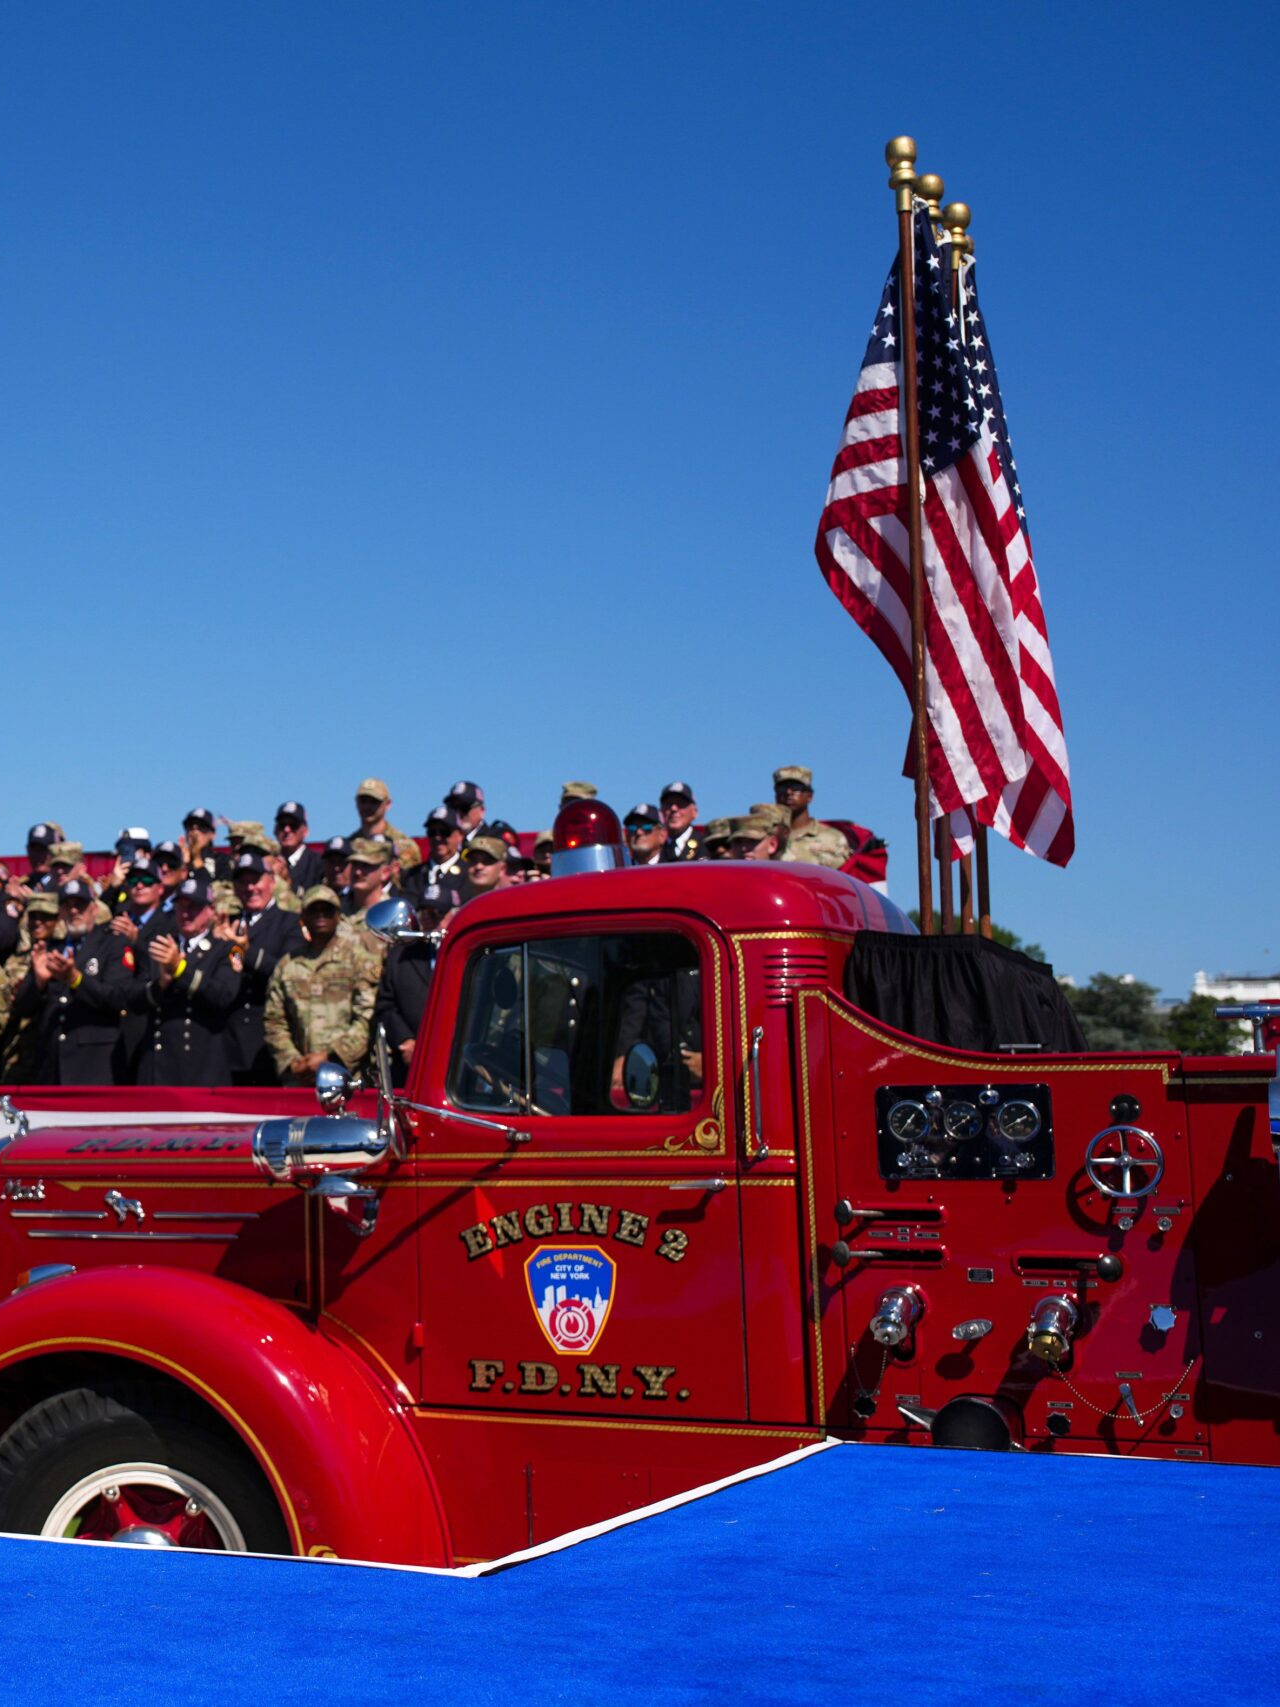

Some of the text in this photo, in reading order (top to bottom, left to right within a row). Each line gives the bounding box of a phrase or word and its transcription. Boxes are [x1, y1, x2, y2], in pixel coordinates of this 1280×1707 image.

[459, 1202, 690, 1262] ENGINE 2
[536, 1253, 604, 1269] FIRE DEPARTMENT
[555, 1264, 585, 1272] CITY OF
[469, 1359, 692, 1400] F.D.N.Y.
